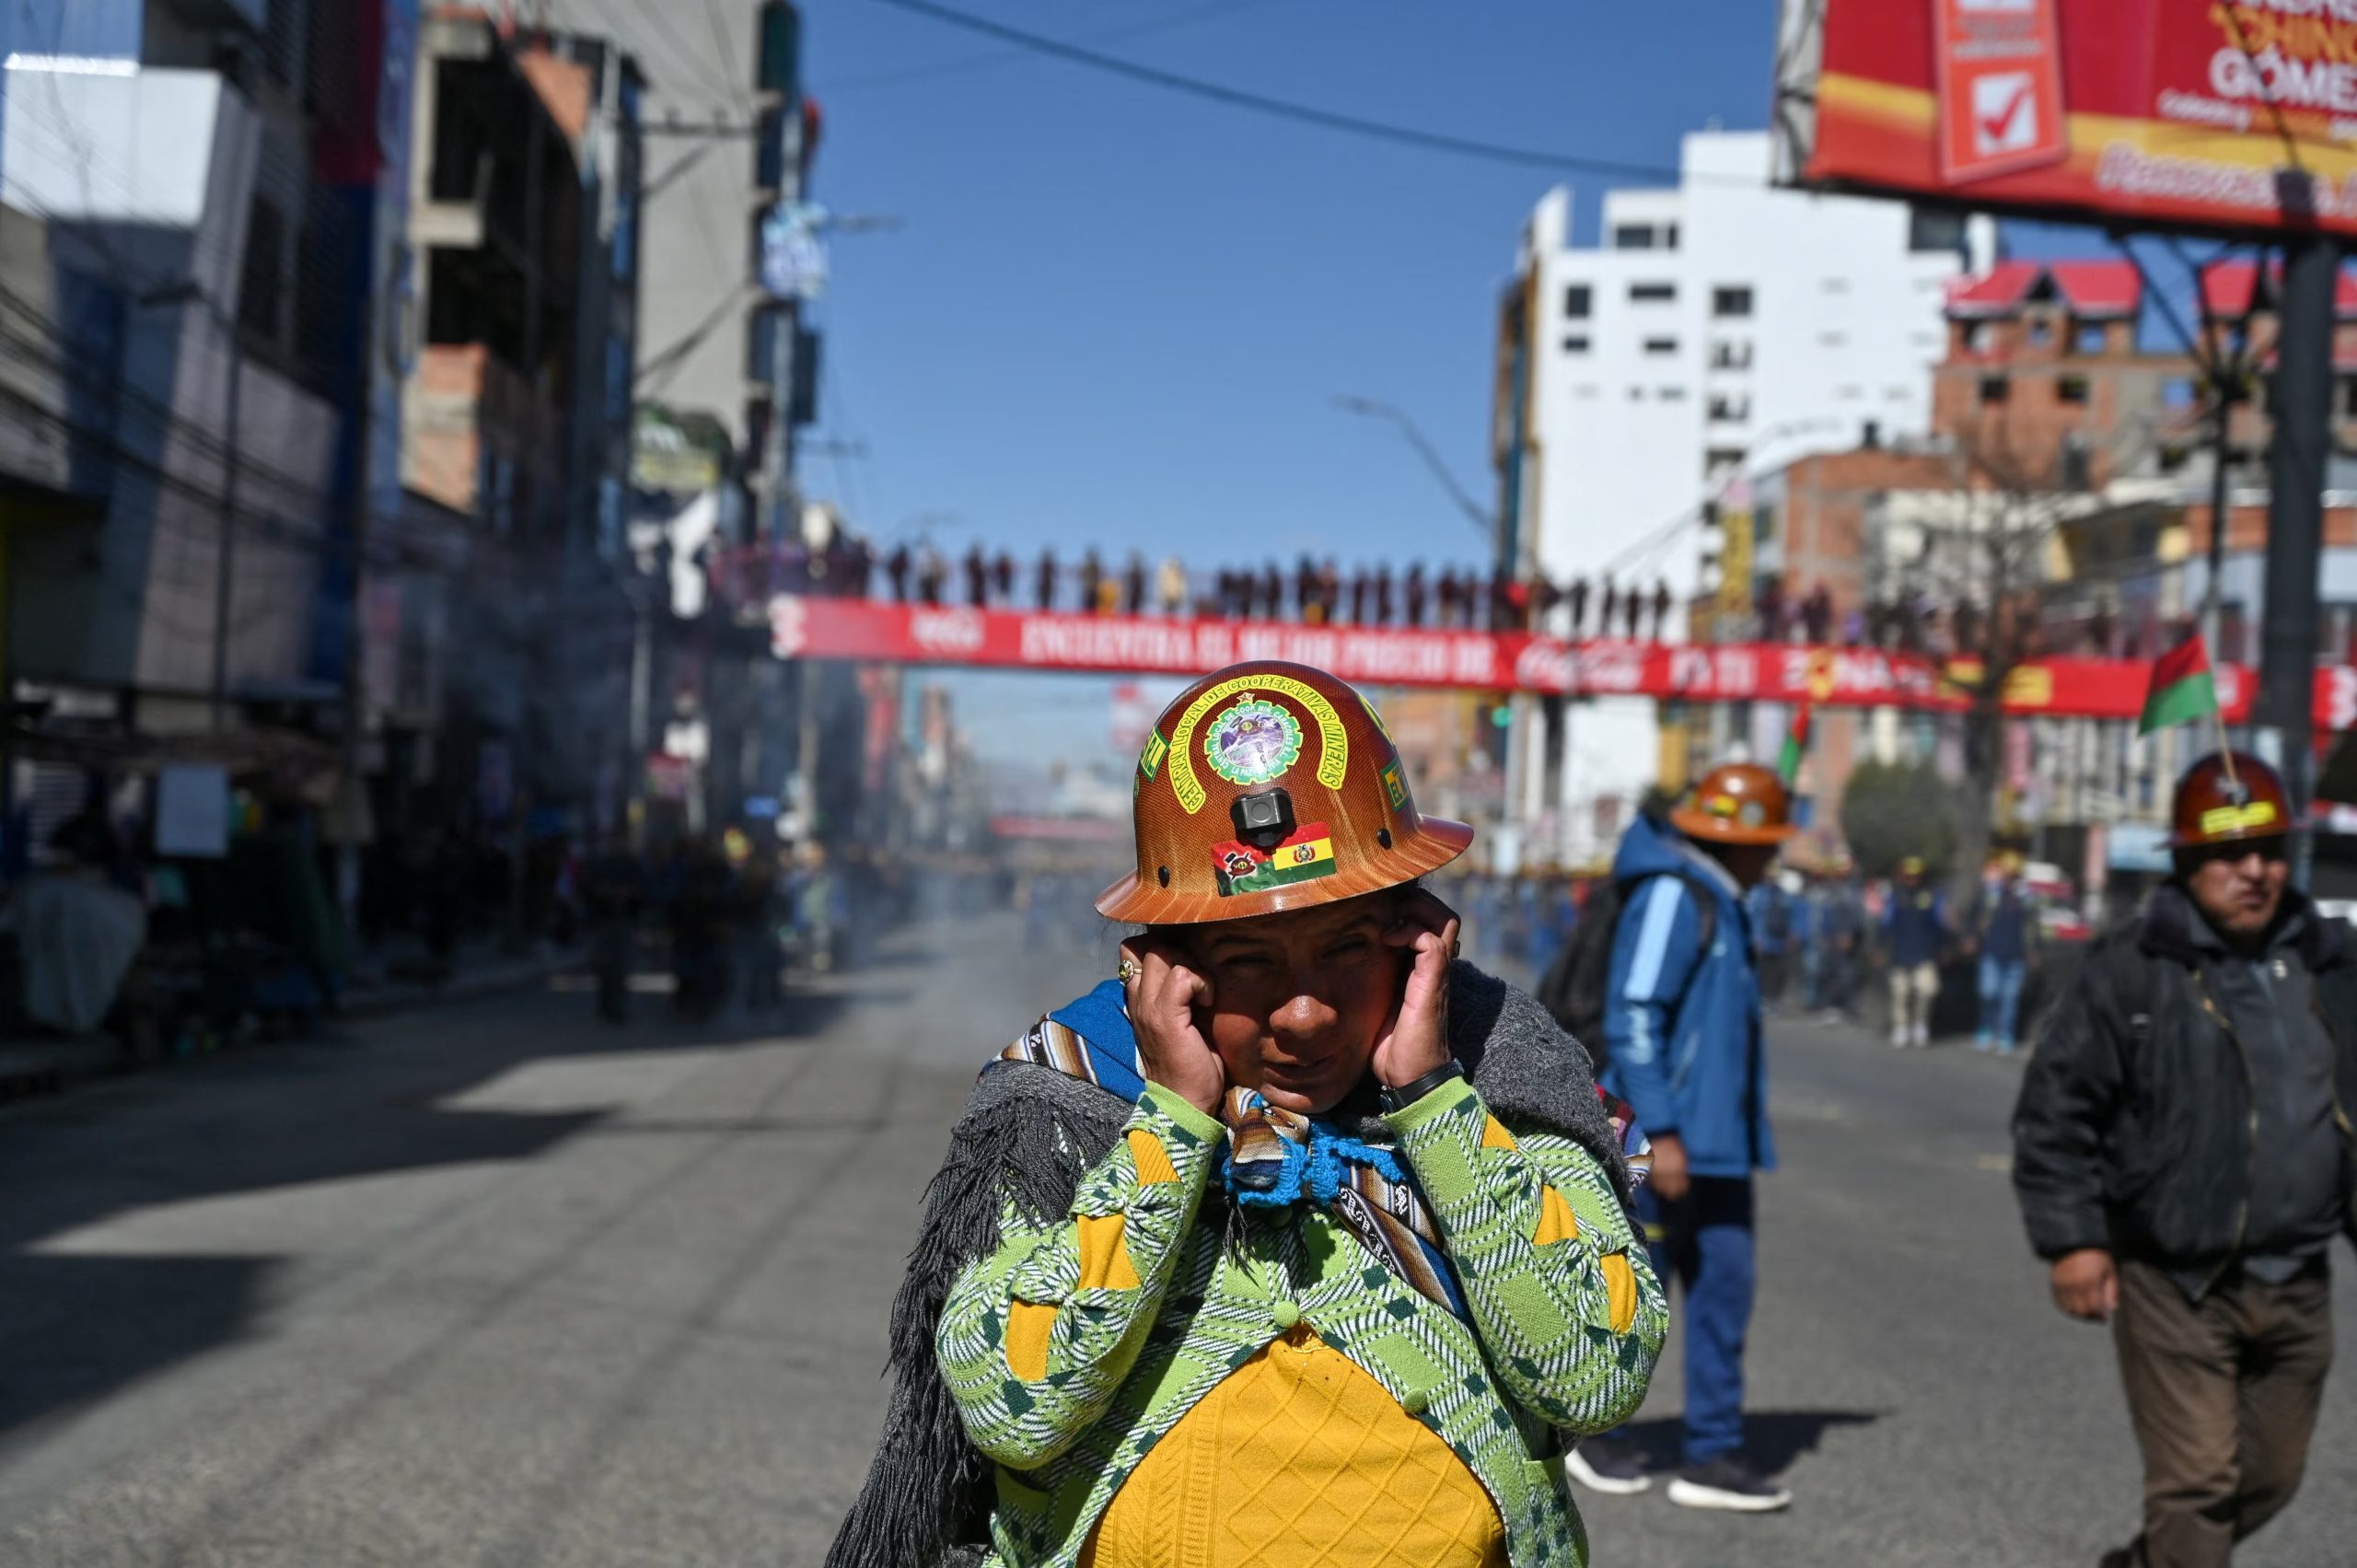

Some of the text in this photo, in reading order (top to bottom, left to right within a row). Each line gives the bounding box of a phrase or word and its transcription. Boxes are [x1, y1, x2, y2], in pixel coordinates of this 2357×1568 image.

[1205, 687, 1226, 704] DE
[1227, 676, 1336, 721] COOPERATIVAS
[1173, 703, 1205, 745] LOCAL
[1213, 721, 1225, 741] LOCAL
[1225, 713, 1235, 721] DE
[1273, 711, 1294, 746] CARACOLES
[1212, 740, 1229, 769] CENTRAL
[1322, 723, 1345, 787] MINERAS
[1169, 747, 1204, 811] CENTRAL
[1231, 768, 1238, 776] LA
